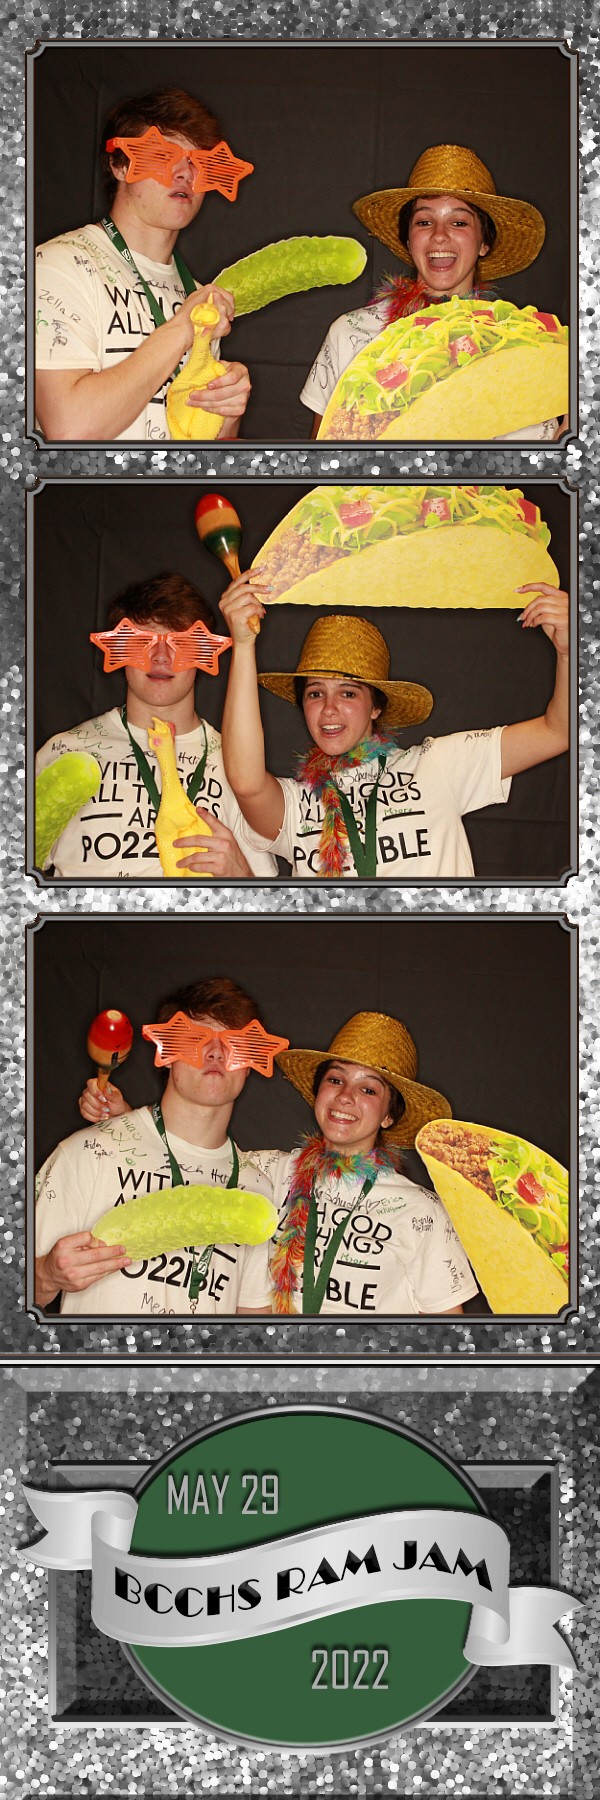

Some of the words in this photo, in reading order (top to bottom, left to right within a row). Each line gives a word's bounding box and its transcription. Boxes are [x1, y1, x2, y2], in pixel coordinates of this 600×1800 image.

[107, 310, 151, 337] ALL
[90, 783, 125, 804] LL
[127, 806, 158, 829] AR
